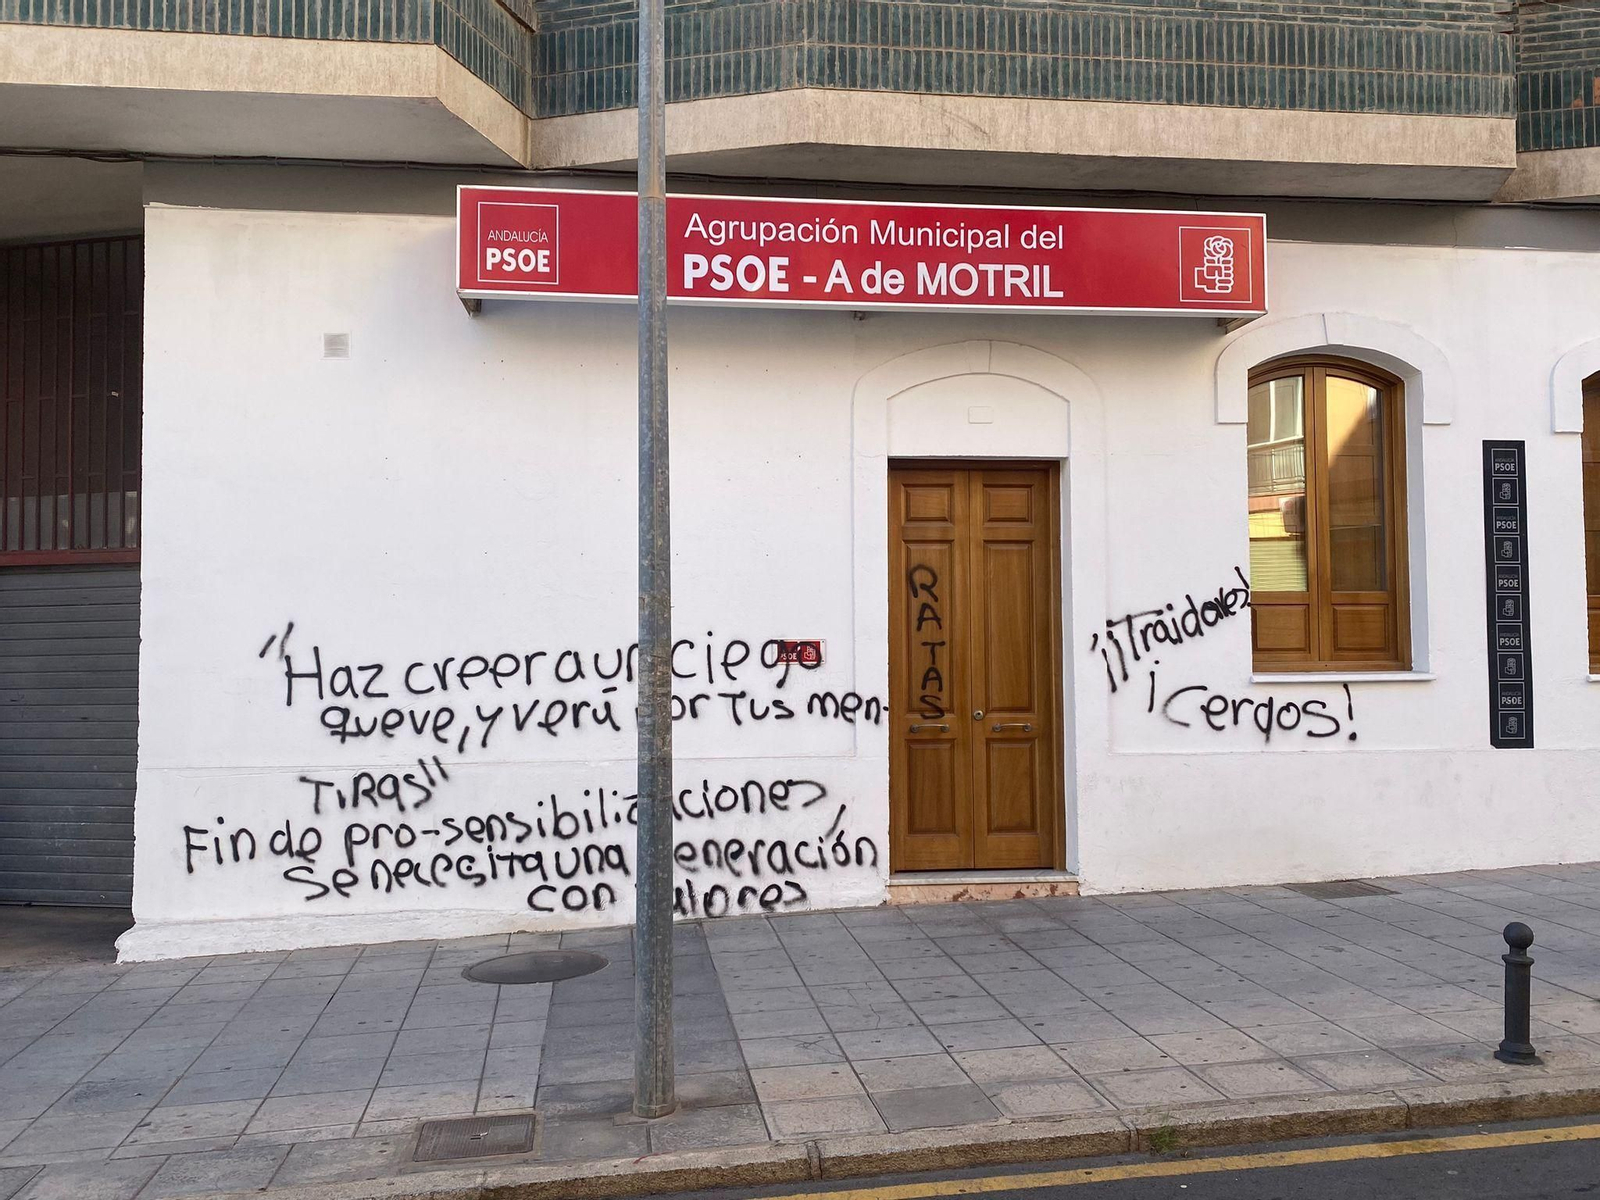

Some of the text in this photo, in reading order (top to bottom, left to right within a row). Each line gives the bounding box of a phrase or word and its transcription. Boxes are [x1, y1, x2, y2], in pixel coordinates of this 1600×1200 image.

[487, 228, 549, 243] ANDALUCÍA
[684, 212, 1064, 254] Agrupación Municipal del
[485, 247, 551, 273] PSOE
[683, 253, 790, 292] PSOE
[860, 263, 905, 294] de
[917, 262, 1064, 298] MOTRIL
[1494, 463, 1516, 472] PSOE
[1496, 520, 1517, 530] PSOE
[1498, 579, 1519, 588] PSOE
[909, 564, 945, 720] RATAS
[1500, 638, 1521, 647] PSOE
[671, 631, 822, 689] ciego
[1502, 696, 1523, 705] PSOE
[183, 816, 256, 874] Fin
[673, 829, 877, 878] eneración
